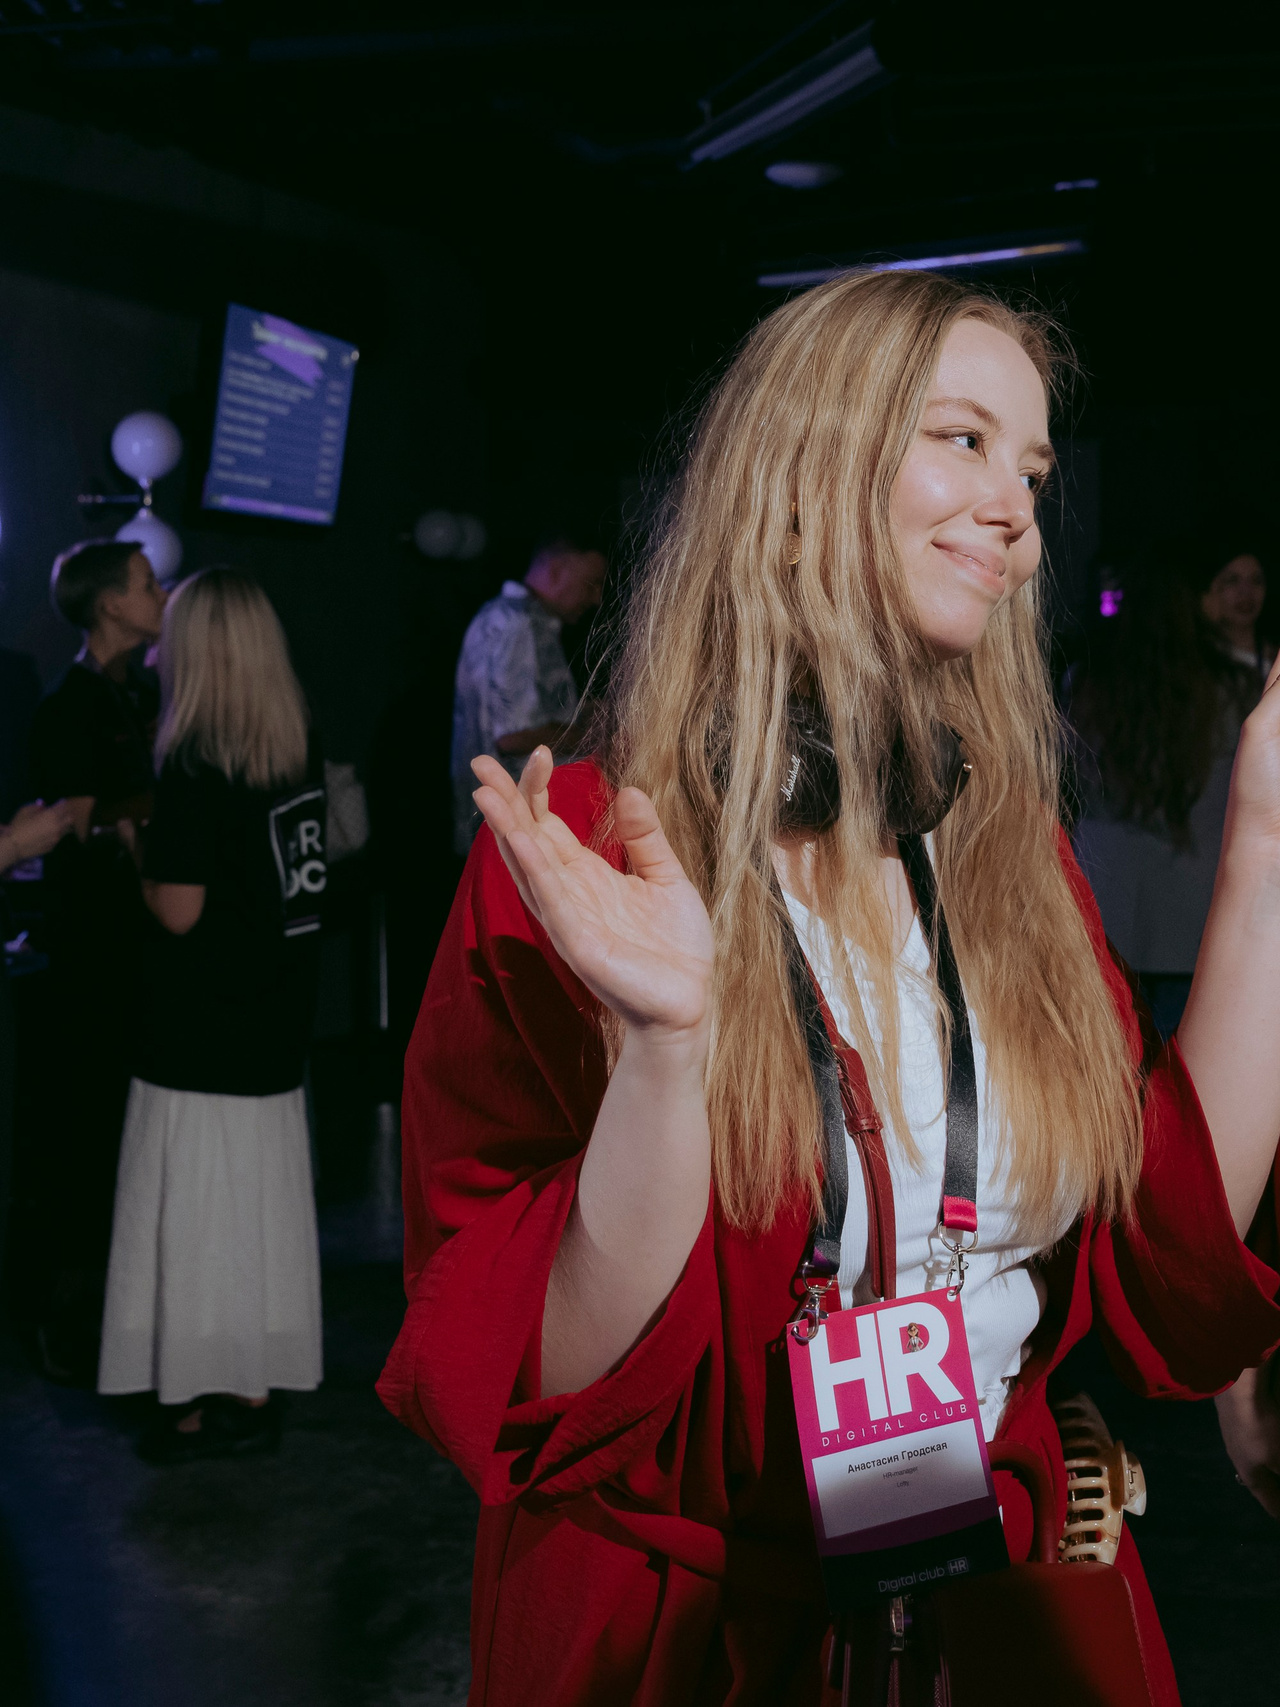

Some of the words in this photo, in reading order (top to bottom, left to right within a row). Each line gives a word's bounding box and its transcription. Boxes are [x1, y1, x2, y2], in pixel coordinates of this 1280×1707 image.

[779, 754, 801, 801] Marshall
[808, 1302, 964, 1433] HR
[822, 1419, 905, 1447] DIGITAL
[919, 1404, 968, 1424] CLUB
[847, 1454, 899, 1474] Анастасия
[901, 1441, 948, 1461] Гродская
[878, 1572, 917, 1593] Digital
[918, 1566, 945, 1582] club
[949, 1559, 967, 1574] HR
